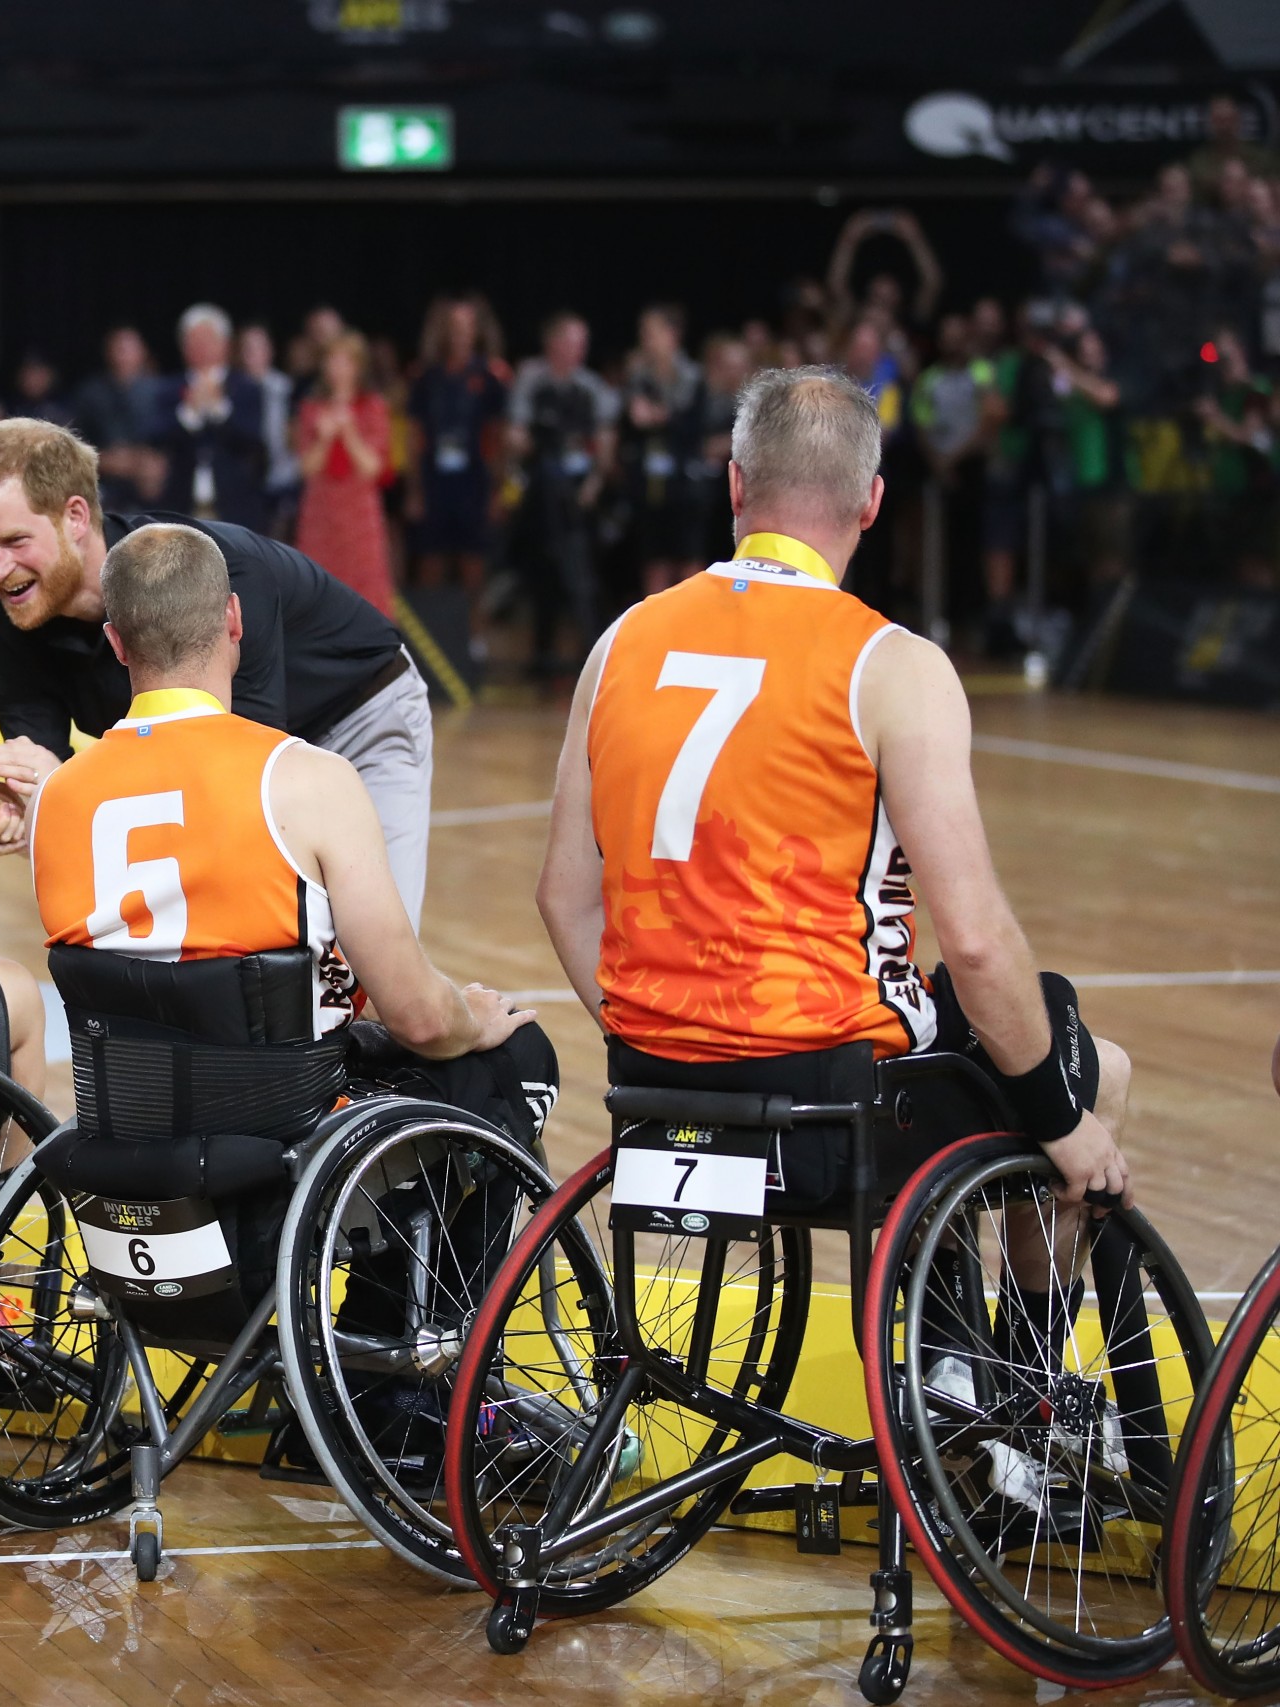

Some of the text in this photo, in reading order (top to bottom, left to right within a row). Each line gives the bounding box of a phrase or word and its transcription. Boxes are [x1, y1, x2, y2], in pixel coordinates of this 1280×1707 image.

[904, 92, 1262, 164] QUAYCENTE
[651, 651, 768, 862] 7
[86, 790, 188, 963] 6
[342, 1119, 378, 1149] KENDA
[666, 1129, 713, 1144] GAMES
[673, 1157, 699, 1203] 7
[103, 1201, 161, 1216] INVICTUS
[109, 1213, 153, 1227] GAMES
[128, 1238, 156, 1276] 6
[71, 1508, 110, 1524] KENDA
